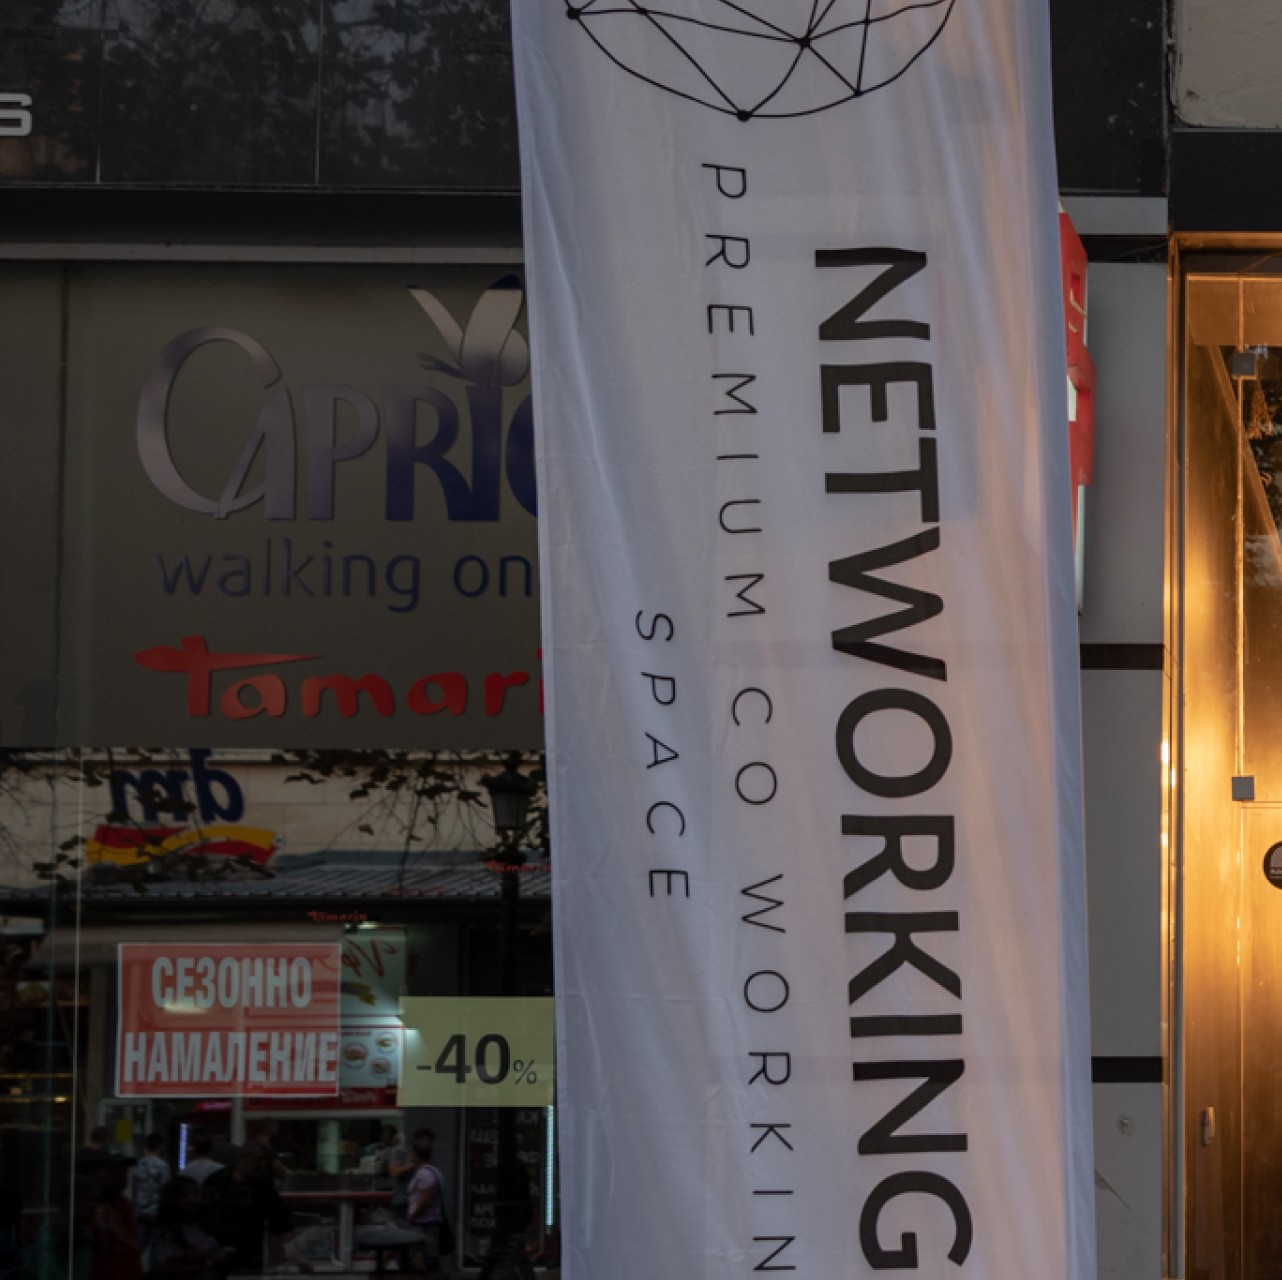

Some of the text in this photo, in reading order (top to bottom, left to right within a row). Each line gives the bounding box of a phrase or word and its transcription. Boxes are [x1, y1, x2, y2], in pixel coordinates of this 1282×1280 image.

[701, 162, 766, 618] PREMIUM
[155, 537, 421, 613] walking
[635, 610, 690, 899] SPACE
[731, 686, 778, 805] CO
[814, 247, 973, 1271] NETWORKING
[151, 956, 312, 1010] СЕЗОННО
[124, 1031, 339, 1084] НАМАЛЕНИЕ
[416, 1033, 540, 1087] -40%
